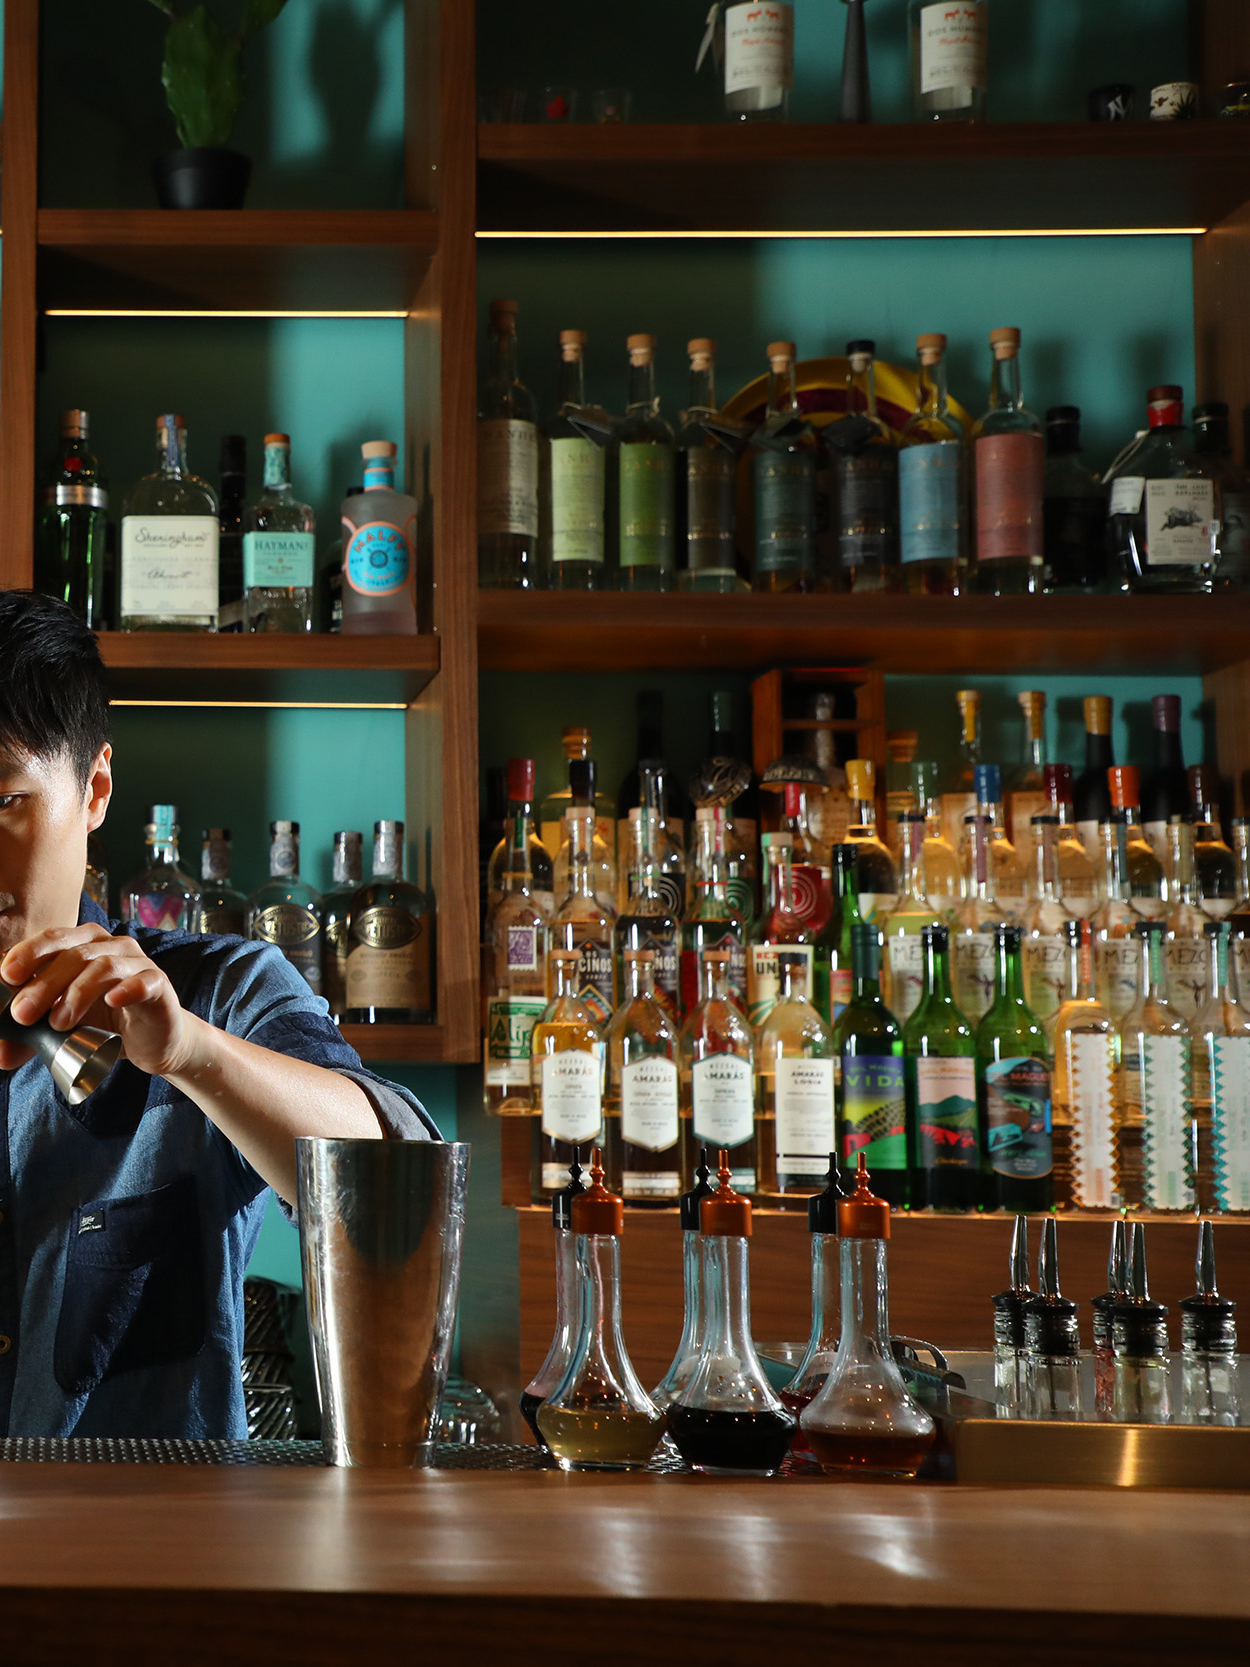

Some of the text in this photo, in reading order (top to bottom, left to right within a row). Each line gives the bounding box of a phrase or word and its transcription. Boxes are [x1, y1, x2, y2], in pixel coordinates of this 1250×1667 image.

[354, 530, 405, 552] MALFY
[578, 958, 613, 972] CINOS
[491, 1017, 531, 1050] Alip
[845, 1074, 905, 1087] VIDA
